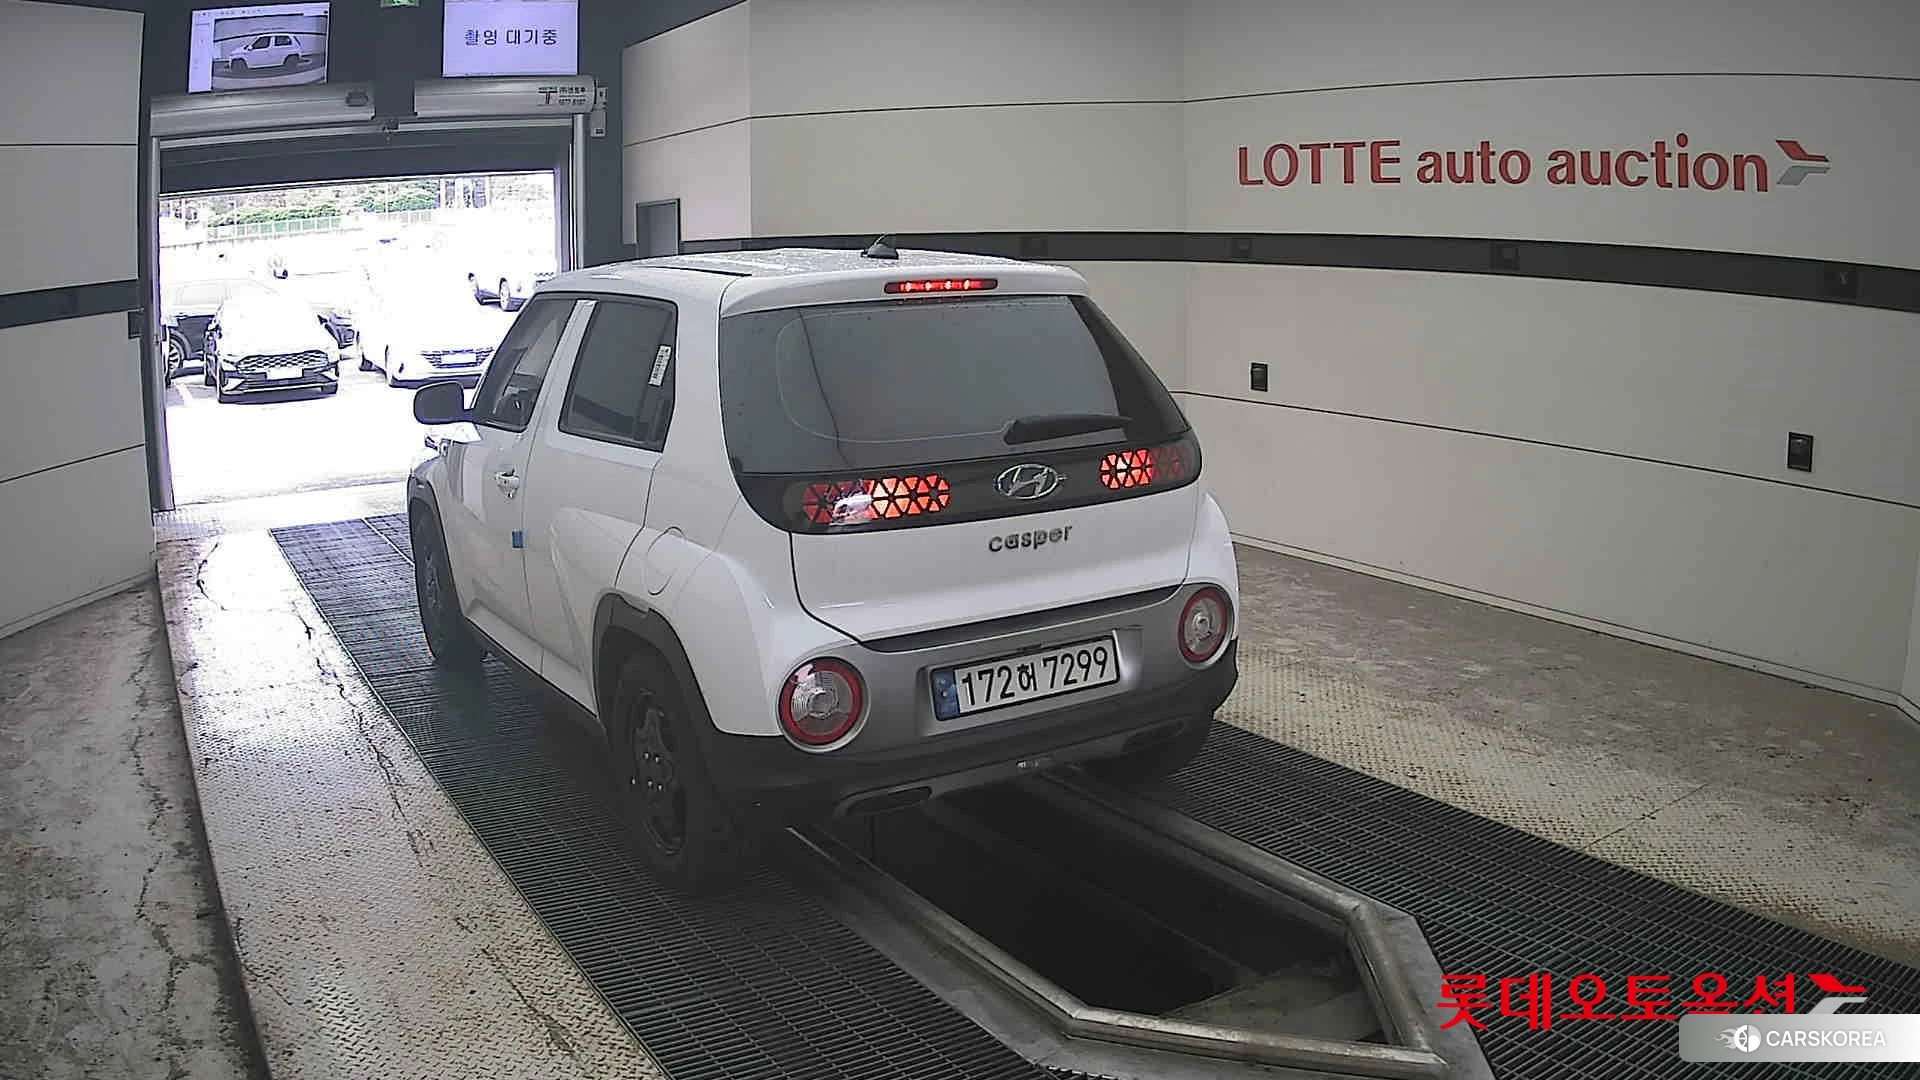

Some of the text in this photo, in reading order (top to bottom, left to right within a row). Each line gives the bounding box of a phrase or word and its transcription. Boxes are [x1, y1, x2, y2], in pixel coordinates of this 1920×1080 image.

[506, 29, 558, 46] 대기중
[1239, 133, 1769, 193] LOTTE auto auction
[988, 525, 1073, 553] casper
